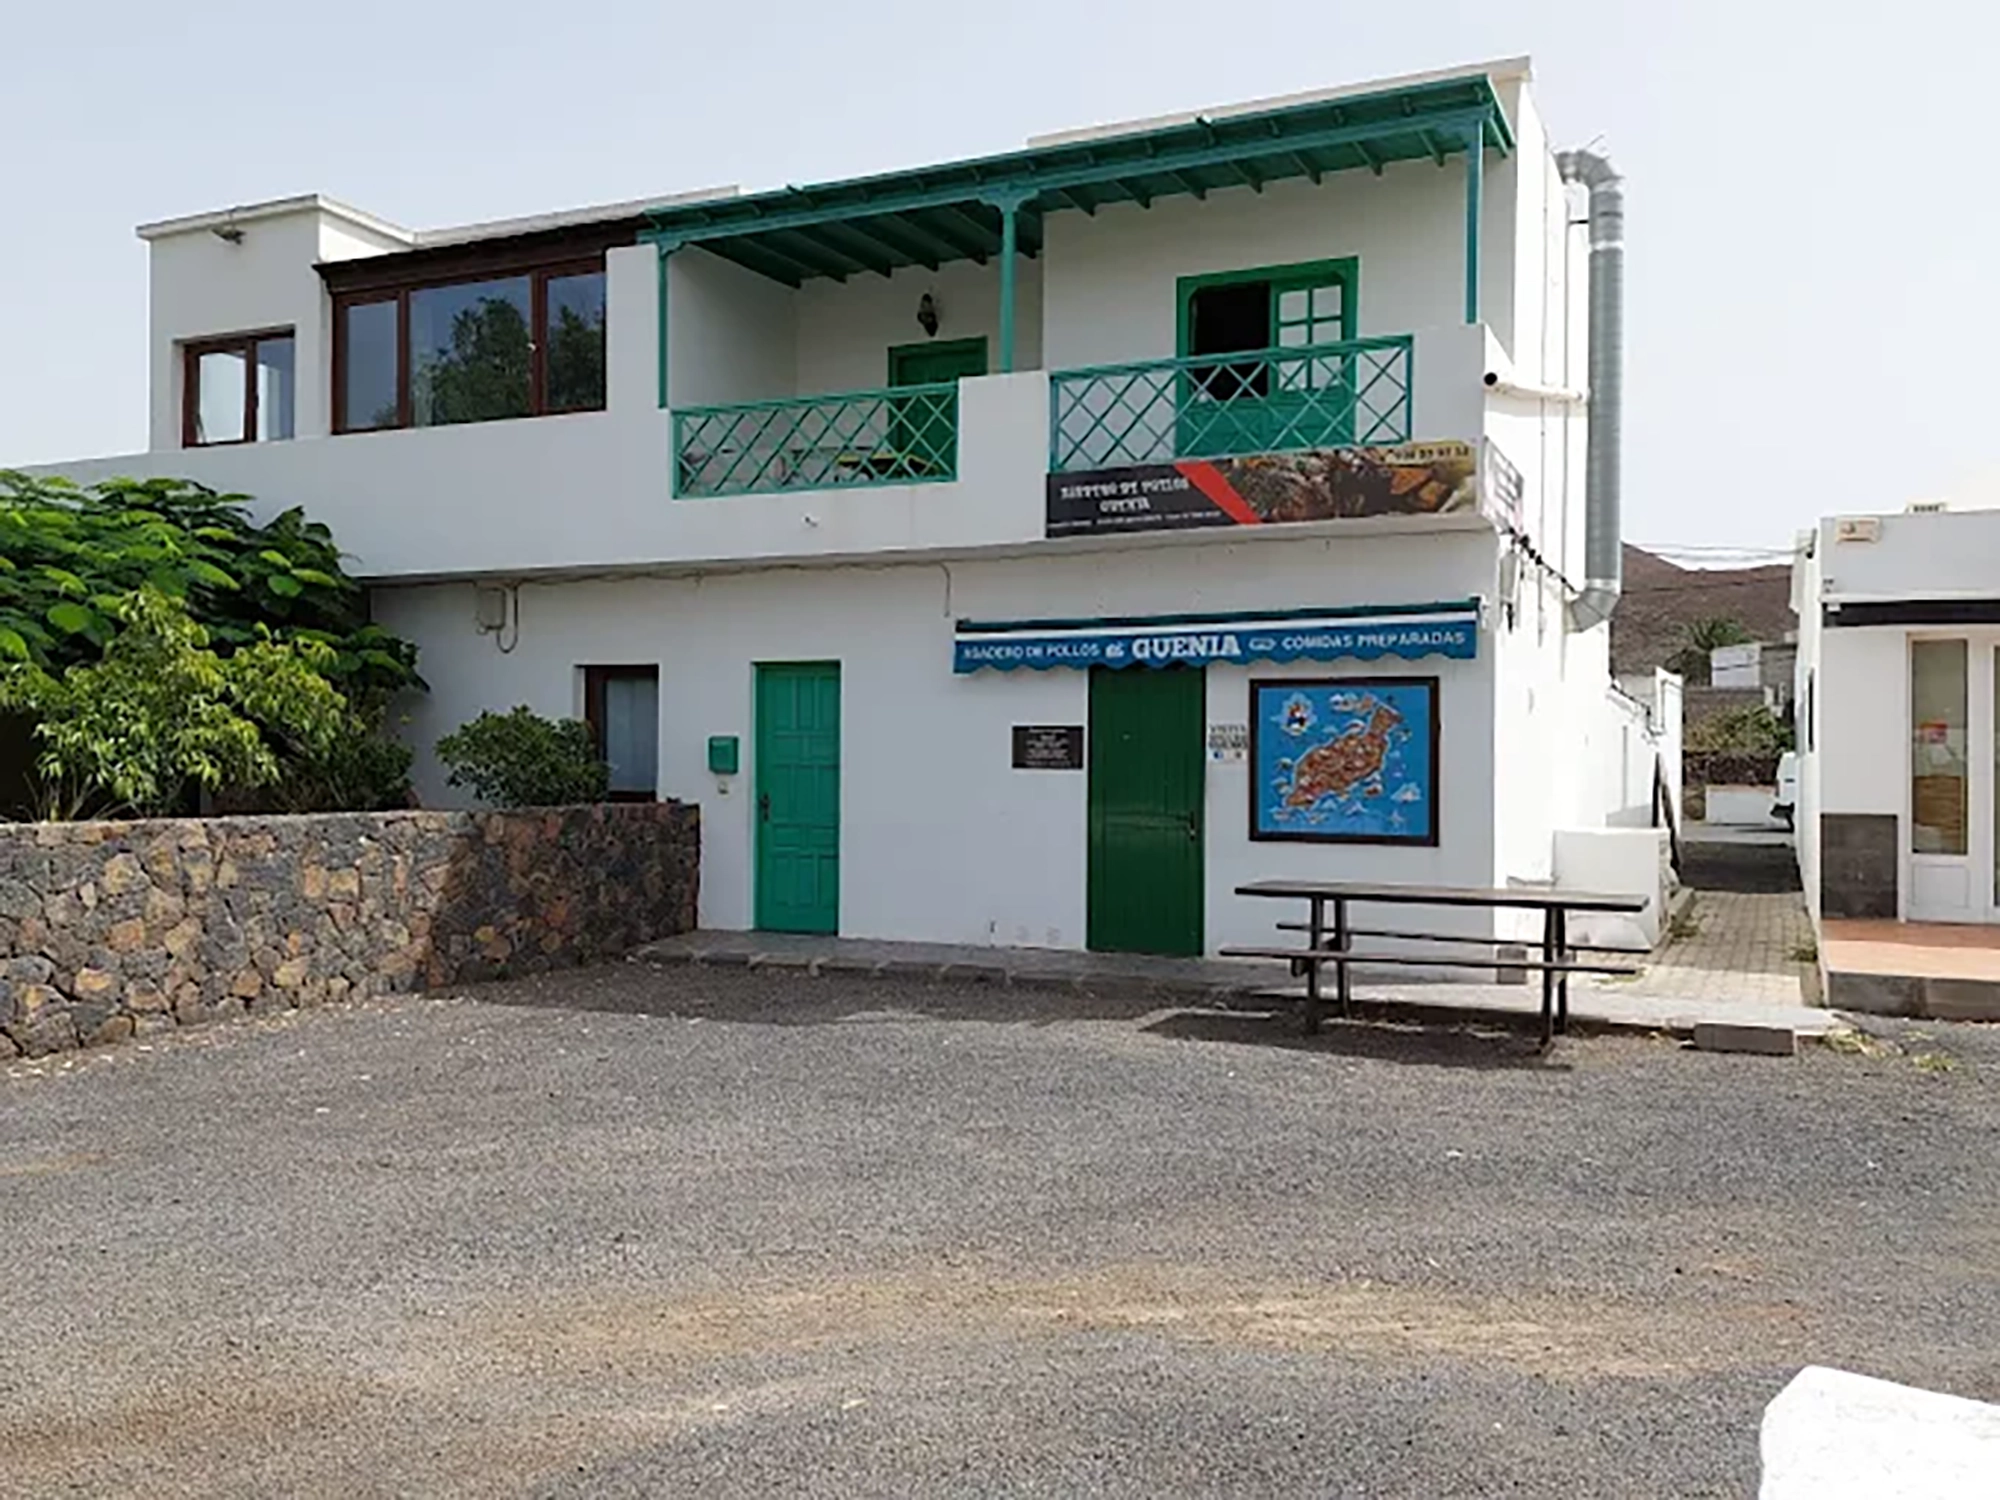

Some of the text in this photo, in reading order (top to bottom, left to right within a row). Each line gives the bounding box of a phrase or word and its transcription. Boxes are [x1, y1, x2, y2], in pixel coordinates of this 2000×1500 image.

[1026, 645, 1042, 657] DE
[1046, 643, 1100, 657] POLLOS
[1132, 634, 1241, 659] GUENIA
[1281, 635, 1353, 651] COMIDAS
[1356, 631, 1465, 648] PREPARADAS
